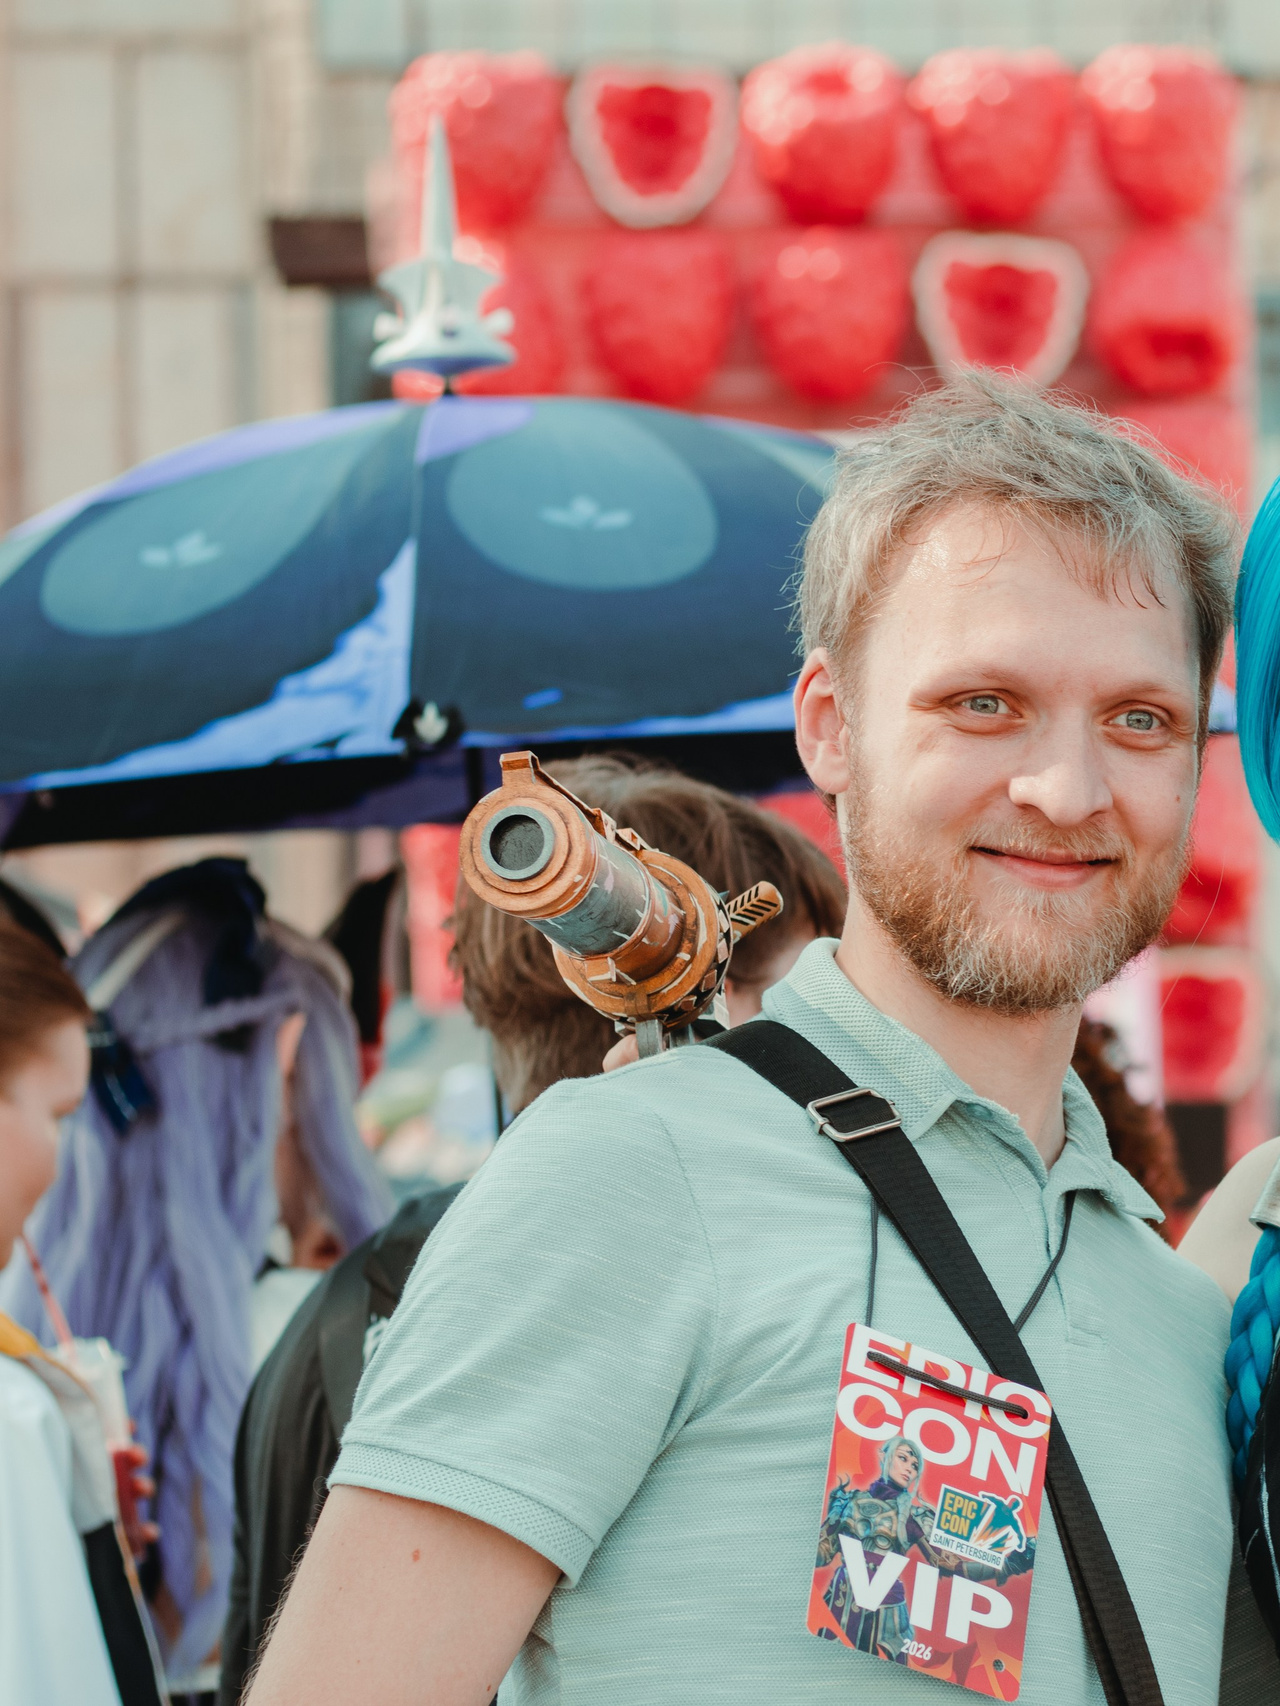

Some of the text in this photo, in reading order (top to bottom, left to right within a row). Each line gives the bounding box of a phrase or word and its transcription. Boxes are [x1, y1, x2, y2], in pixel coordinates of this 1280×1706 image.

[846, 1323, 1052, 1439] EPIC
[837, 1383, 1038, 1497] CON
[943, 1492, 978, 1520] EPIC
[940, 1511, 970, 1537] CON
[933, 1533, 1002, 1566] SAINT PETERSBURG
[838, 1533, 1013, 1644] VIP
[900, 1638, 933, 1661] 2026
